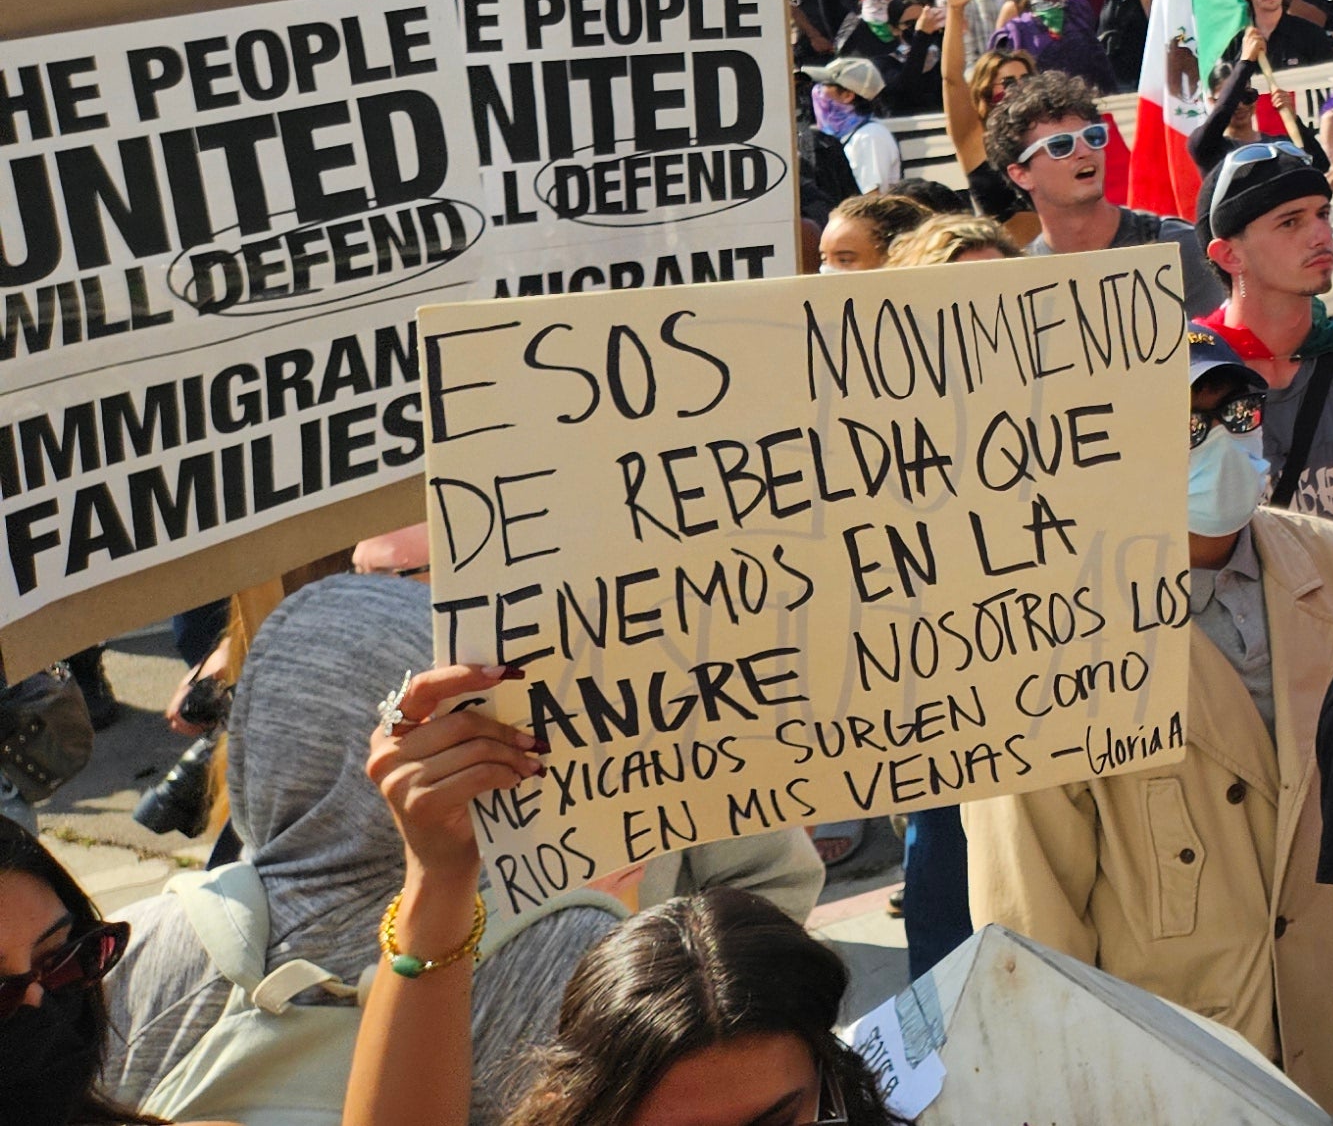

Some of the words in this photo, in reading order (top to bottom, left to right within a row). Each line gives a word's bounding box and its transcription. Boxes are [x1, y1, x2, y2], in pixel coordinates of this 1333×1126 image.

[126, 7, 438, 123] PEOPLE
[466, 50, 765, 167] NITED
[188, 203, 467, 315] DEFEND
[551, 148, 768, 219] DEFEND
[0, 322, 419, 500] IMMIGRAN
[423, 310, 730, 444] ESOS
[803, 264, 1188, 403] MOVIMIENTOS
[3, 391, 426, 598] FAMILIES
[430, 469, 562, 573] DE
[617, 418, 953, 542] REBELDIA
[976, 403, 1122, 492] QUE
[433, 544, 814, 680] TENEMOS
[843, 521, 936, 605] EN
[970, 493, 1078, 576] LA
[450, 647, 808, 755] ANGRE
[855, 588, 1105, 691] NOSOTROS
[1131, 569, 1193, 630] LOS
[474, 735, 745, 845] MEXICANOS
[775, 685, 986, 766] SURGEN
[496, 825, 595, 915] RIOS
[622, 800, 697, 861] EN
[729, 778, 817, 839] MIS
[843, 730, 1032, 807] VENAS
